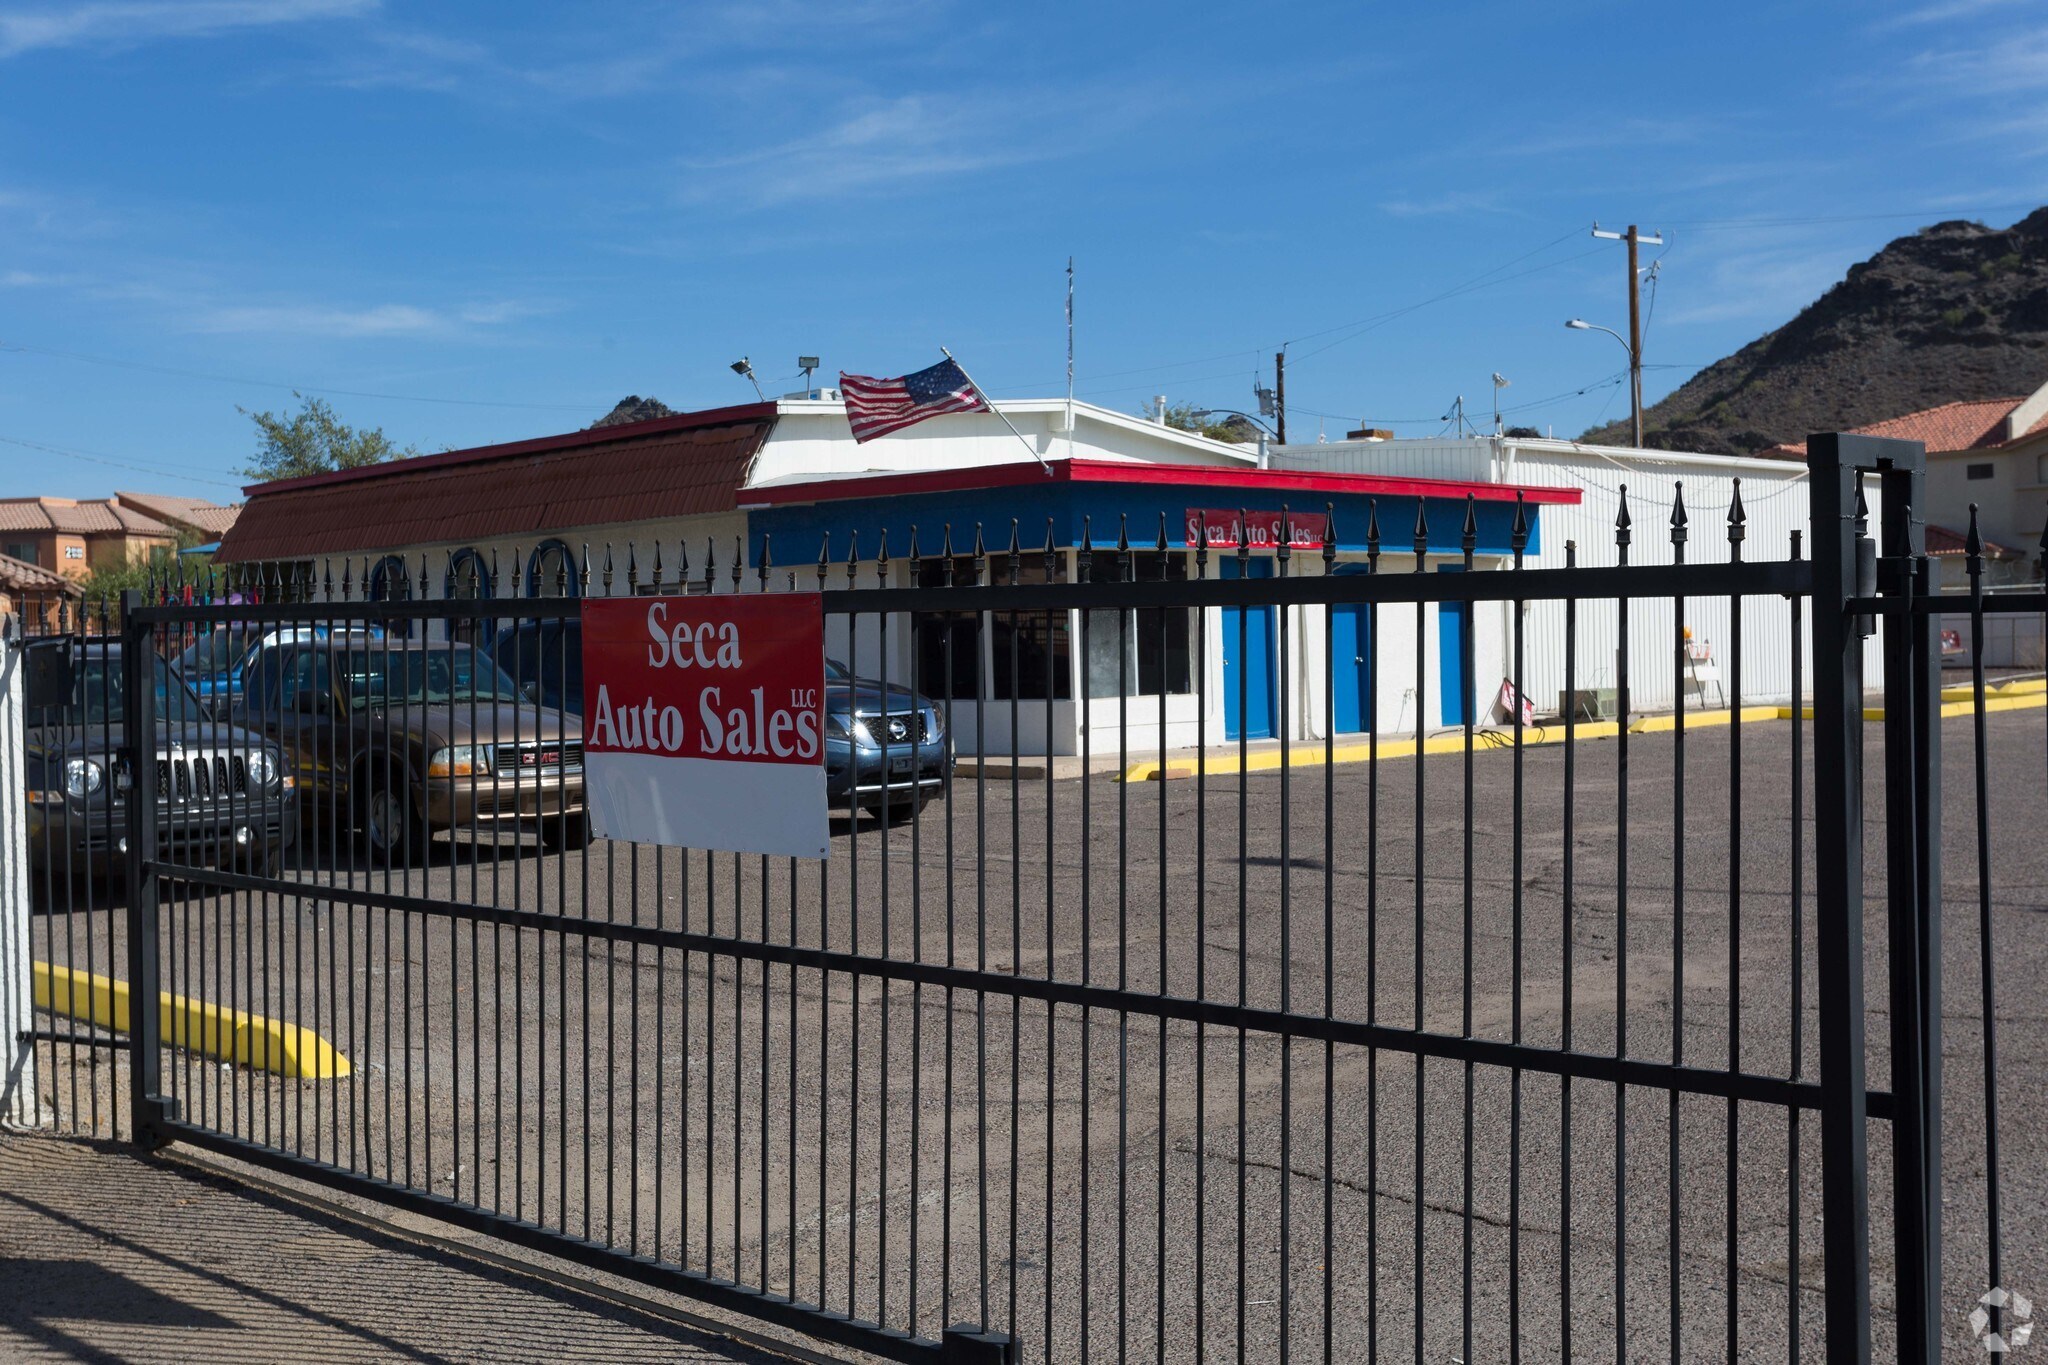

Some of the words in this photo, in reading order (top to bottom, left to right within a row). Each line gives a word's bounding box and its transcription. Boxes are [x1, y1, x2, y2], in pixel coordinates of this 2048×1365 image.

[1188, 518, 1225, 543] Sca
[1271, 520, 1311, 545] Sles
[647, 602, 742, 669] Seca
[588, 684, 684, 751] Auto
[699, 686, 818, 758] Sales
[791, 688, 816, 708] LLC
